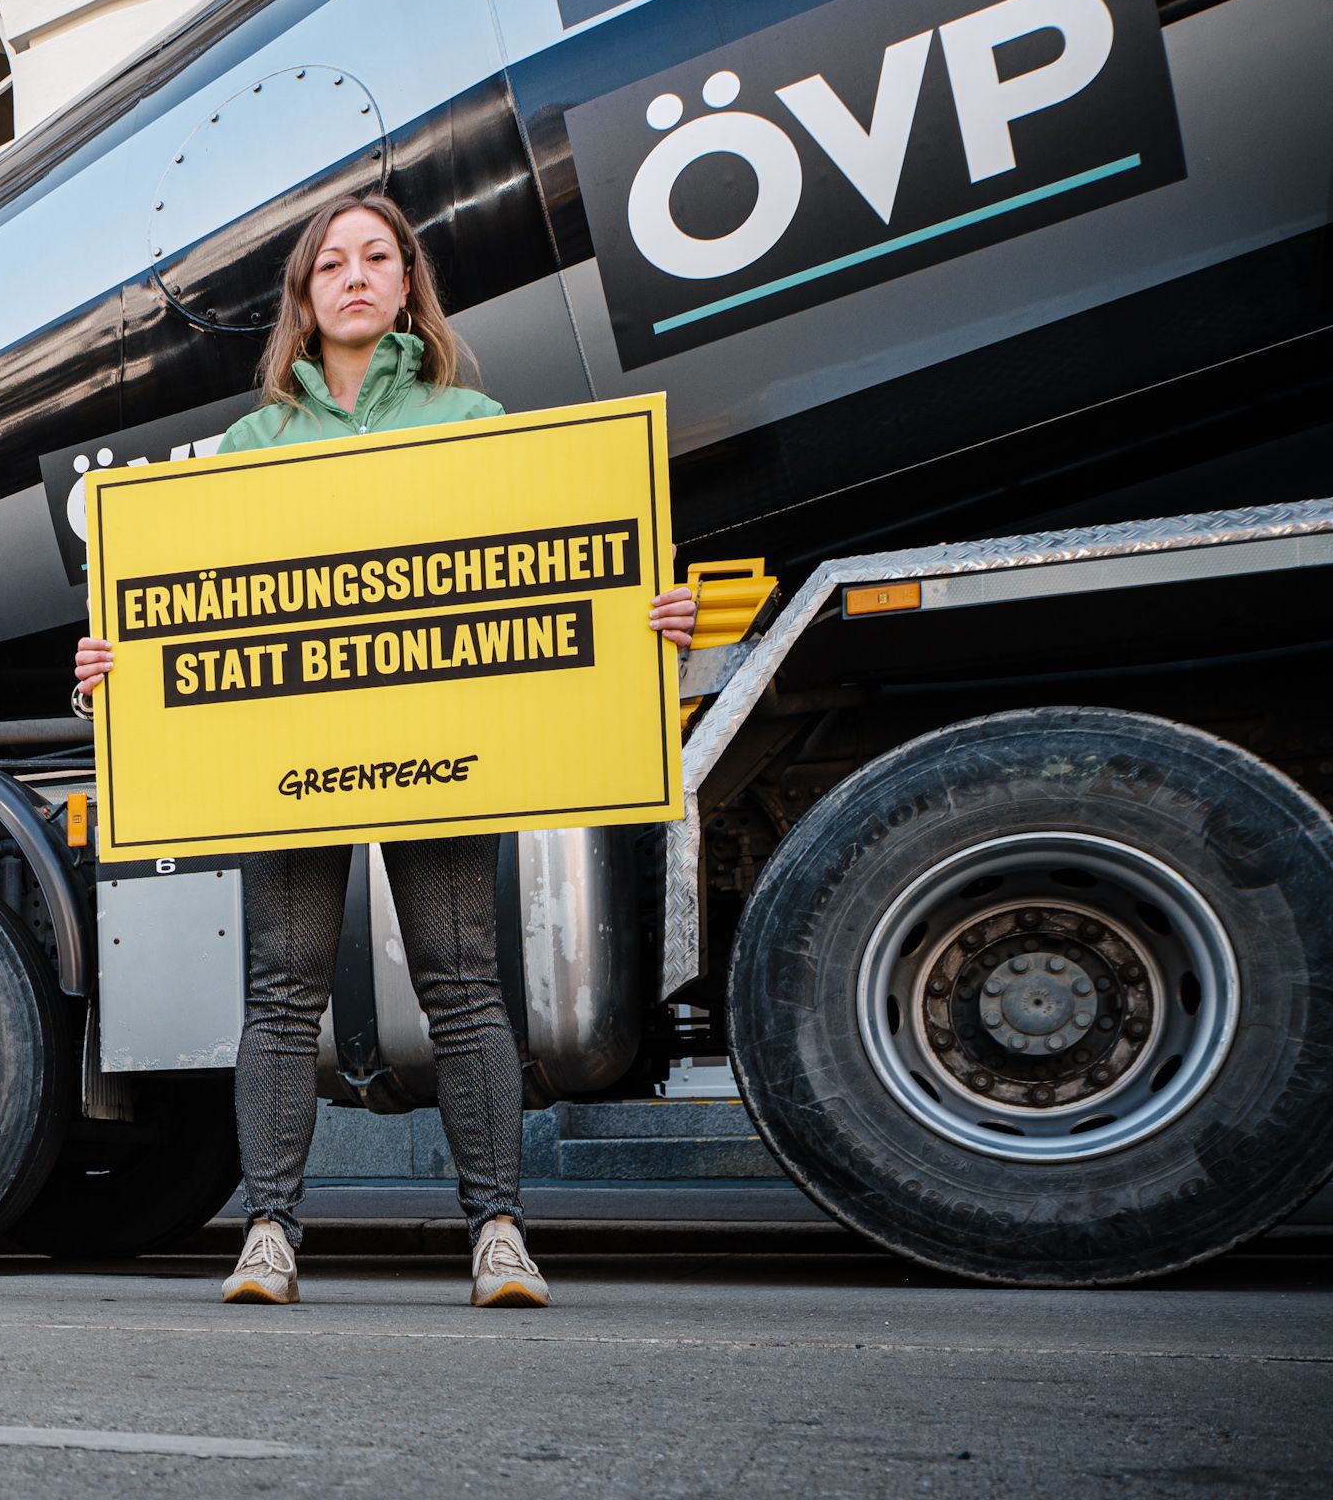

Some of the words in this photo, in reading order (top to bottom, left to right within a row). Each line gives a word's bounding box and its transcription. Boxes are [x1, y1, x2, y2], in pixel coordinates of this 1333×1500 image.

[124, 531, 630, 630] ERNÄHRUNGSSICHERHEIT
[175, 644, 288, 695] STATT
[301, 612, 579, 682] BETONLAWINE
[277, 754, 479, 801] GREENPEACE
